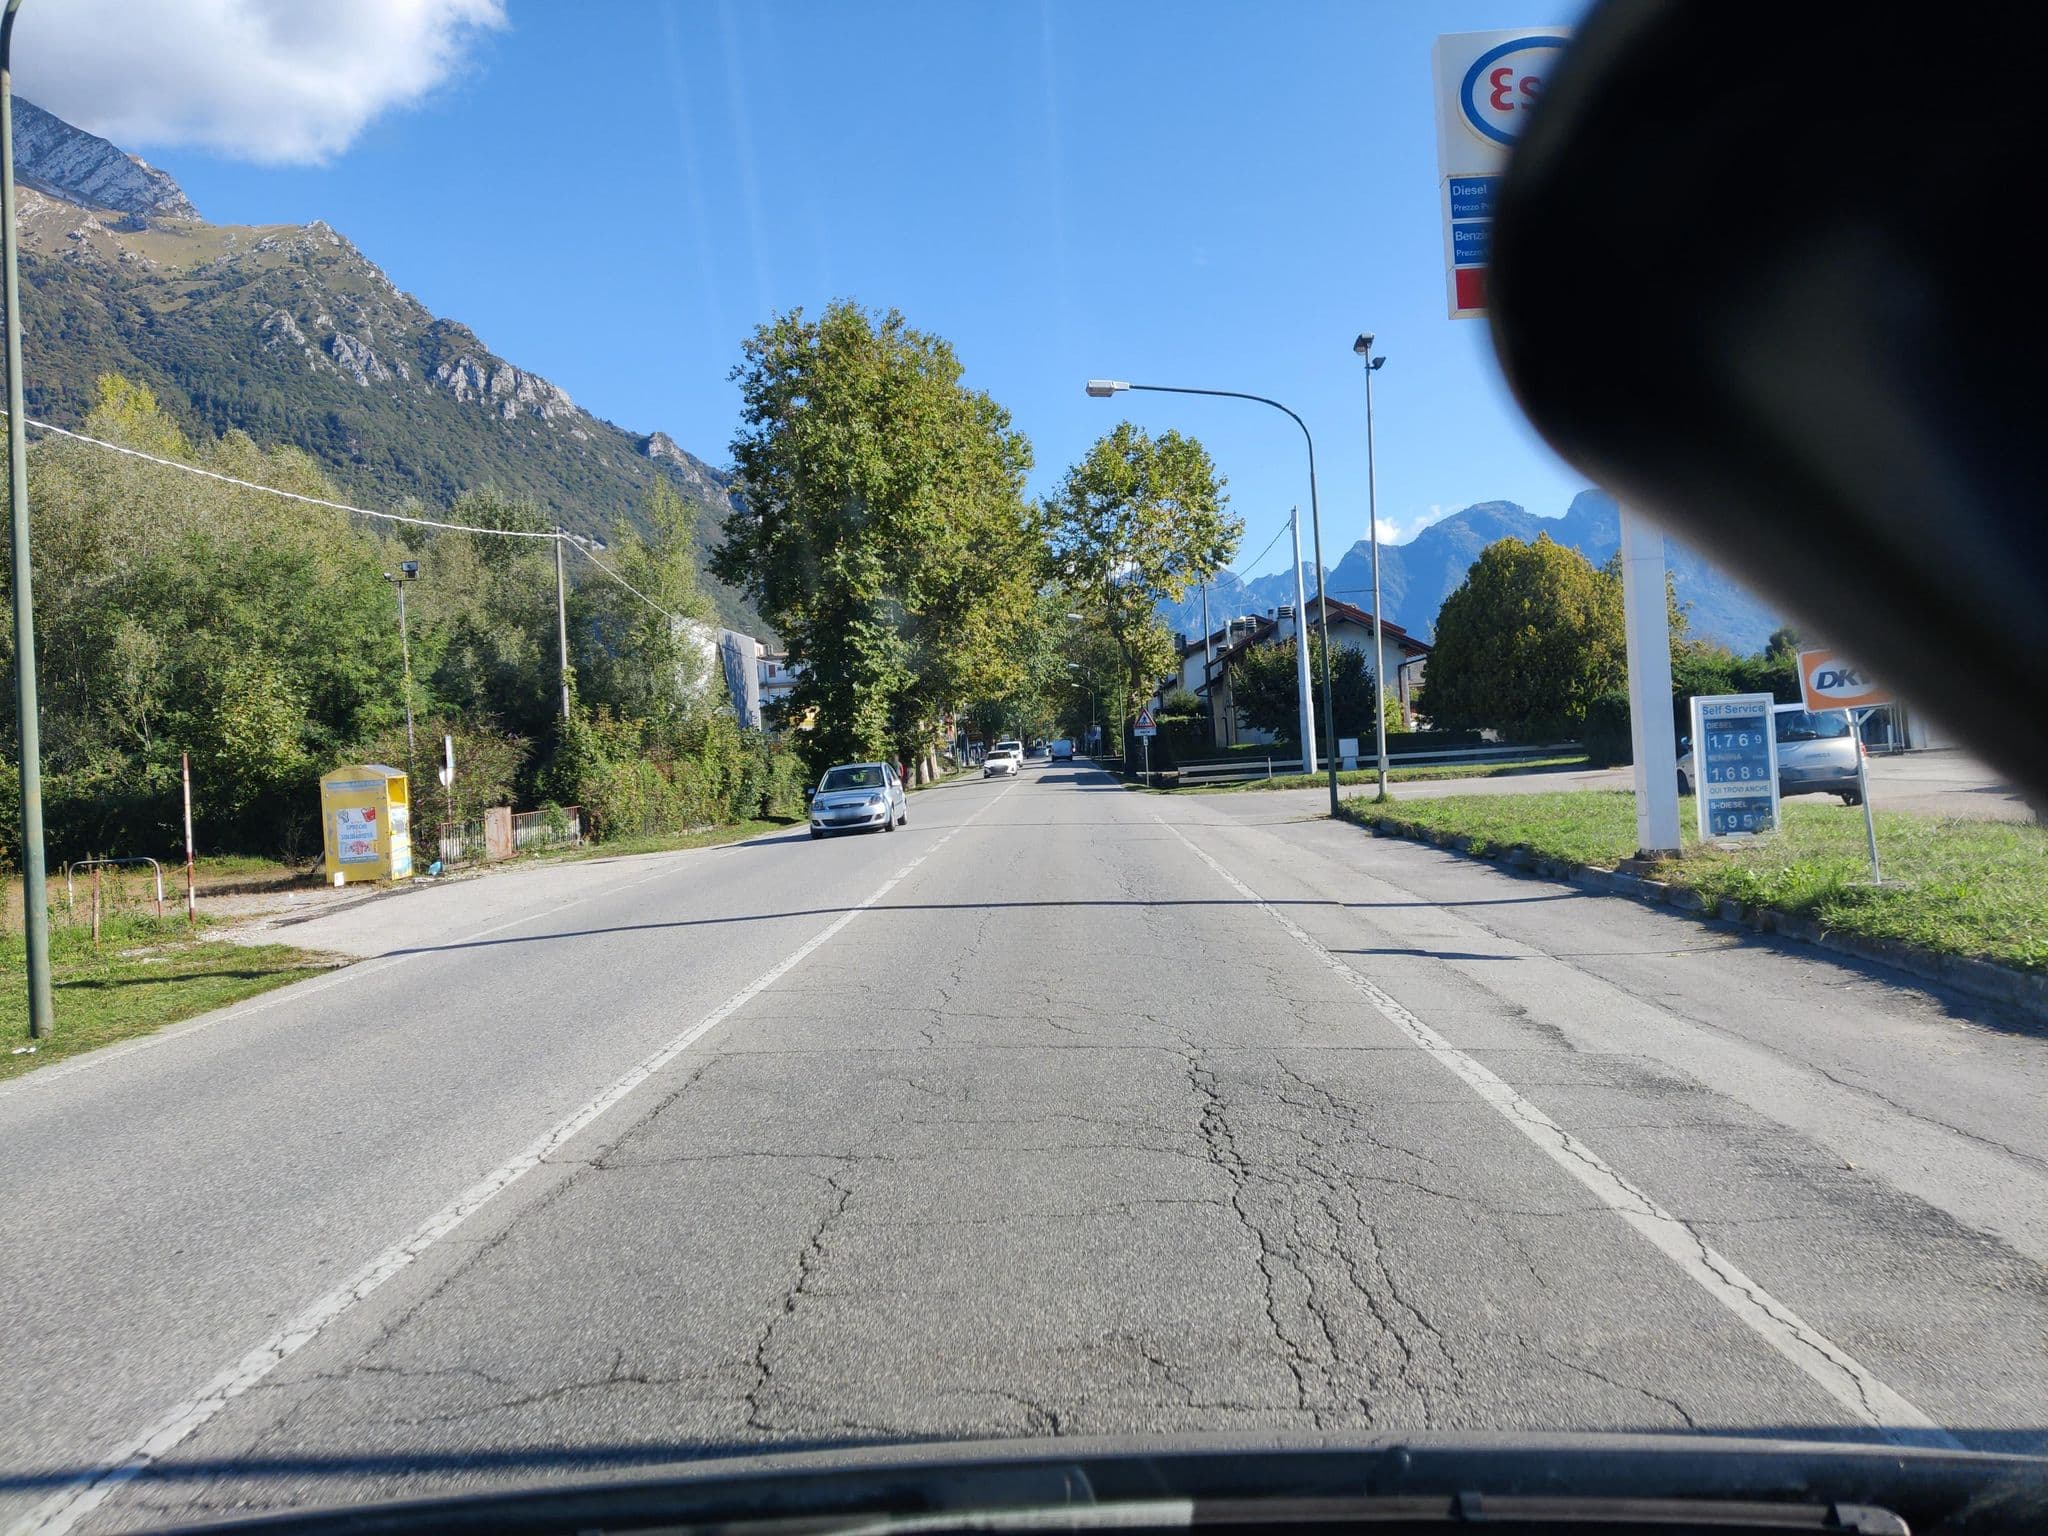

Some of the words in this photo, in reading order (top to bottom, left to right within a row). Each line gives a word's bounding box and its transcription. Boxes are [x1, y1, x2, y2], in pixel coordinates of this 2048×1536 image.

[1452, 184, 1488, 196] Diesel
[1453, 204, 1480, 212] Prezzo
[1703, 705, 1722, 716] Self
[1725, 703, 1765, 714] Service
[1706, 721, 1734, 730] DIESEL
